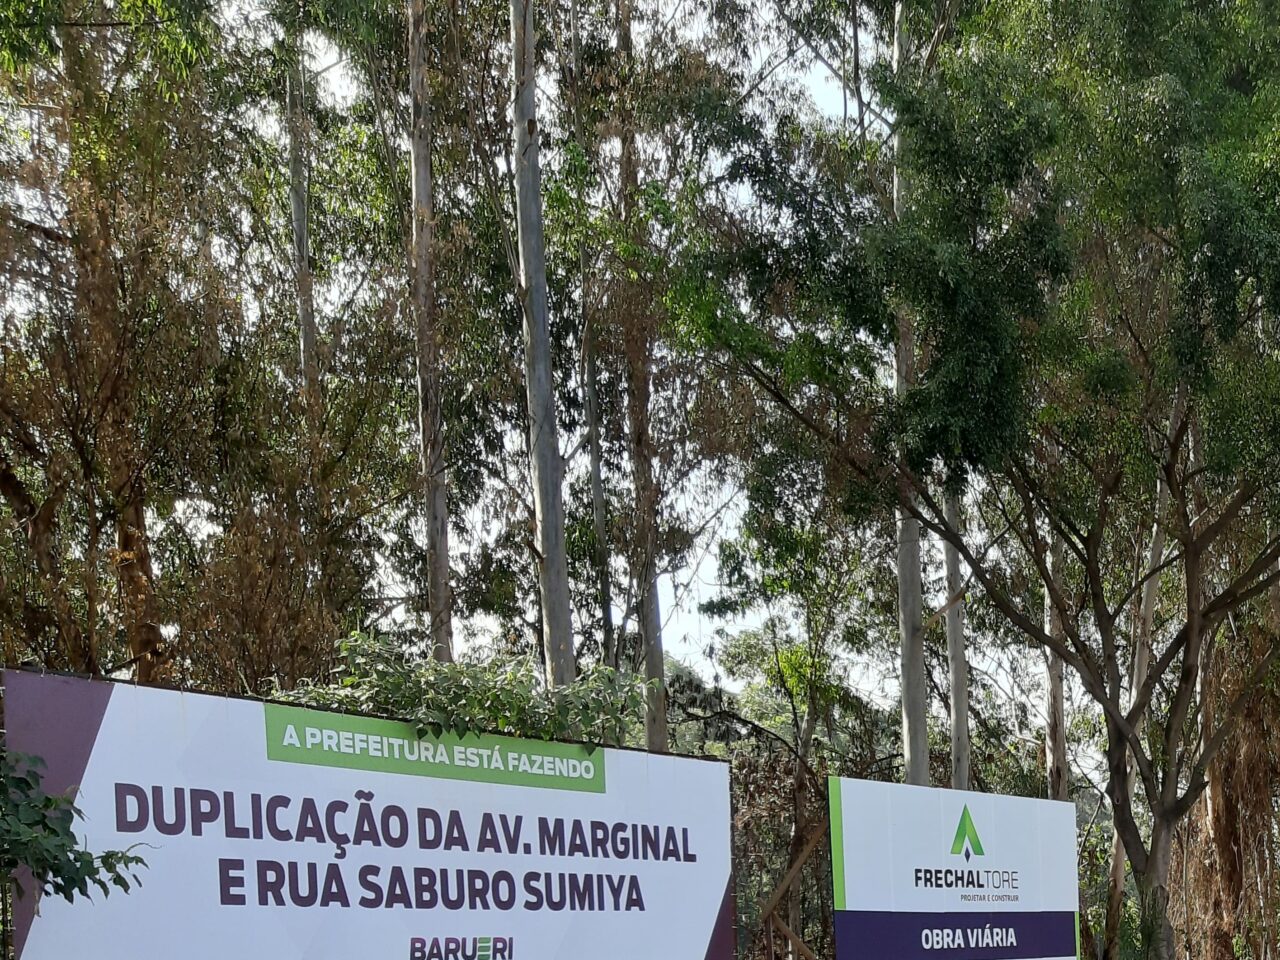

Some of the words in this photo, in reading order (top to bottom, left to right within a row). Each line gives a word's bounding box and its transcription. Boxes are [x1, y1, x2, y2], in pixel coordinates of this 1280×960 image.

[282, 724, 301, 748] A
[304, 726, 450, 765] PREFEITURA
[453, 744, 505, 771] ESTÁ
[507, 752, 595, 780] FAZENDO
[114, 782, 409, 859] DUPLICAÇÃO
[416, 807, 469, 851] DA
[476, 812, 532, 855] AV.
[537, 816, 697, 863] MARGINAL
[218, 858, 247, 906] E
[256, 859, 351, 908] RUA
[358, 864, 517, 911] SABURO
[522, 871, 646, 912] SUMIYA
[914, 868, 1019, 889] FRECHALTORE
[960, 894, 986, 902] PROJETAR
[991, 894, 1020, 902] CONSTRUIR
[921, 928, 965, 950] OBRA
[966, 923, 1017, 948] VIÁRIA
